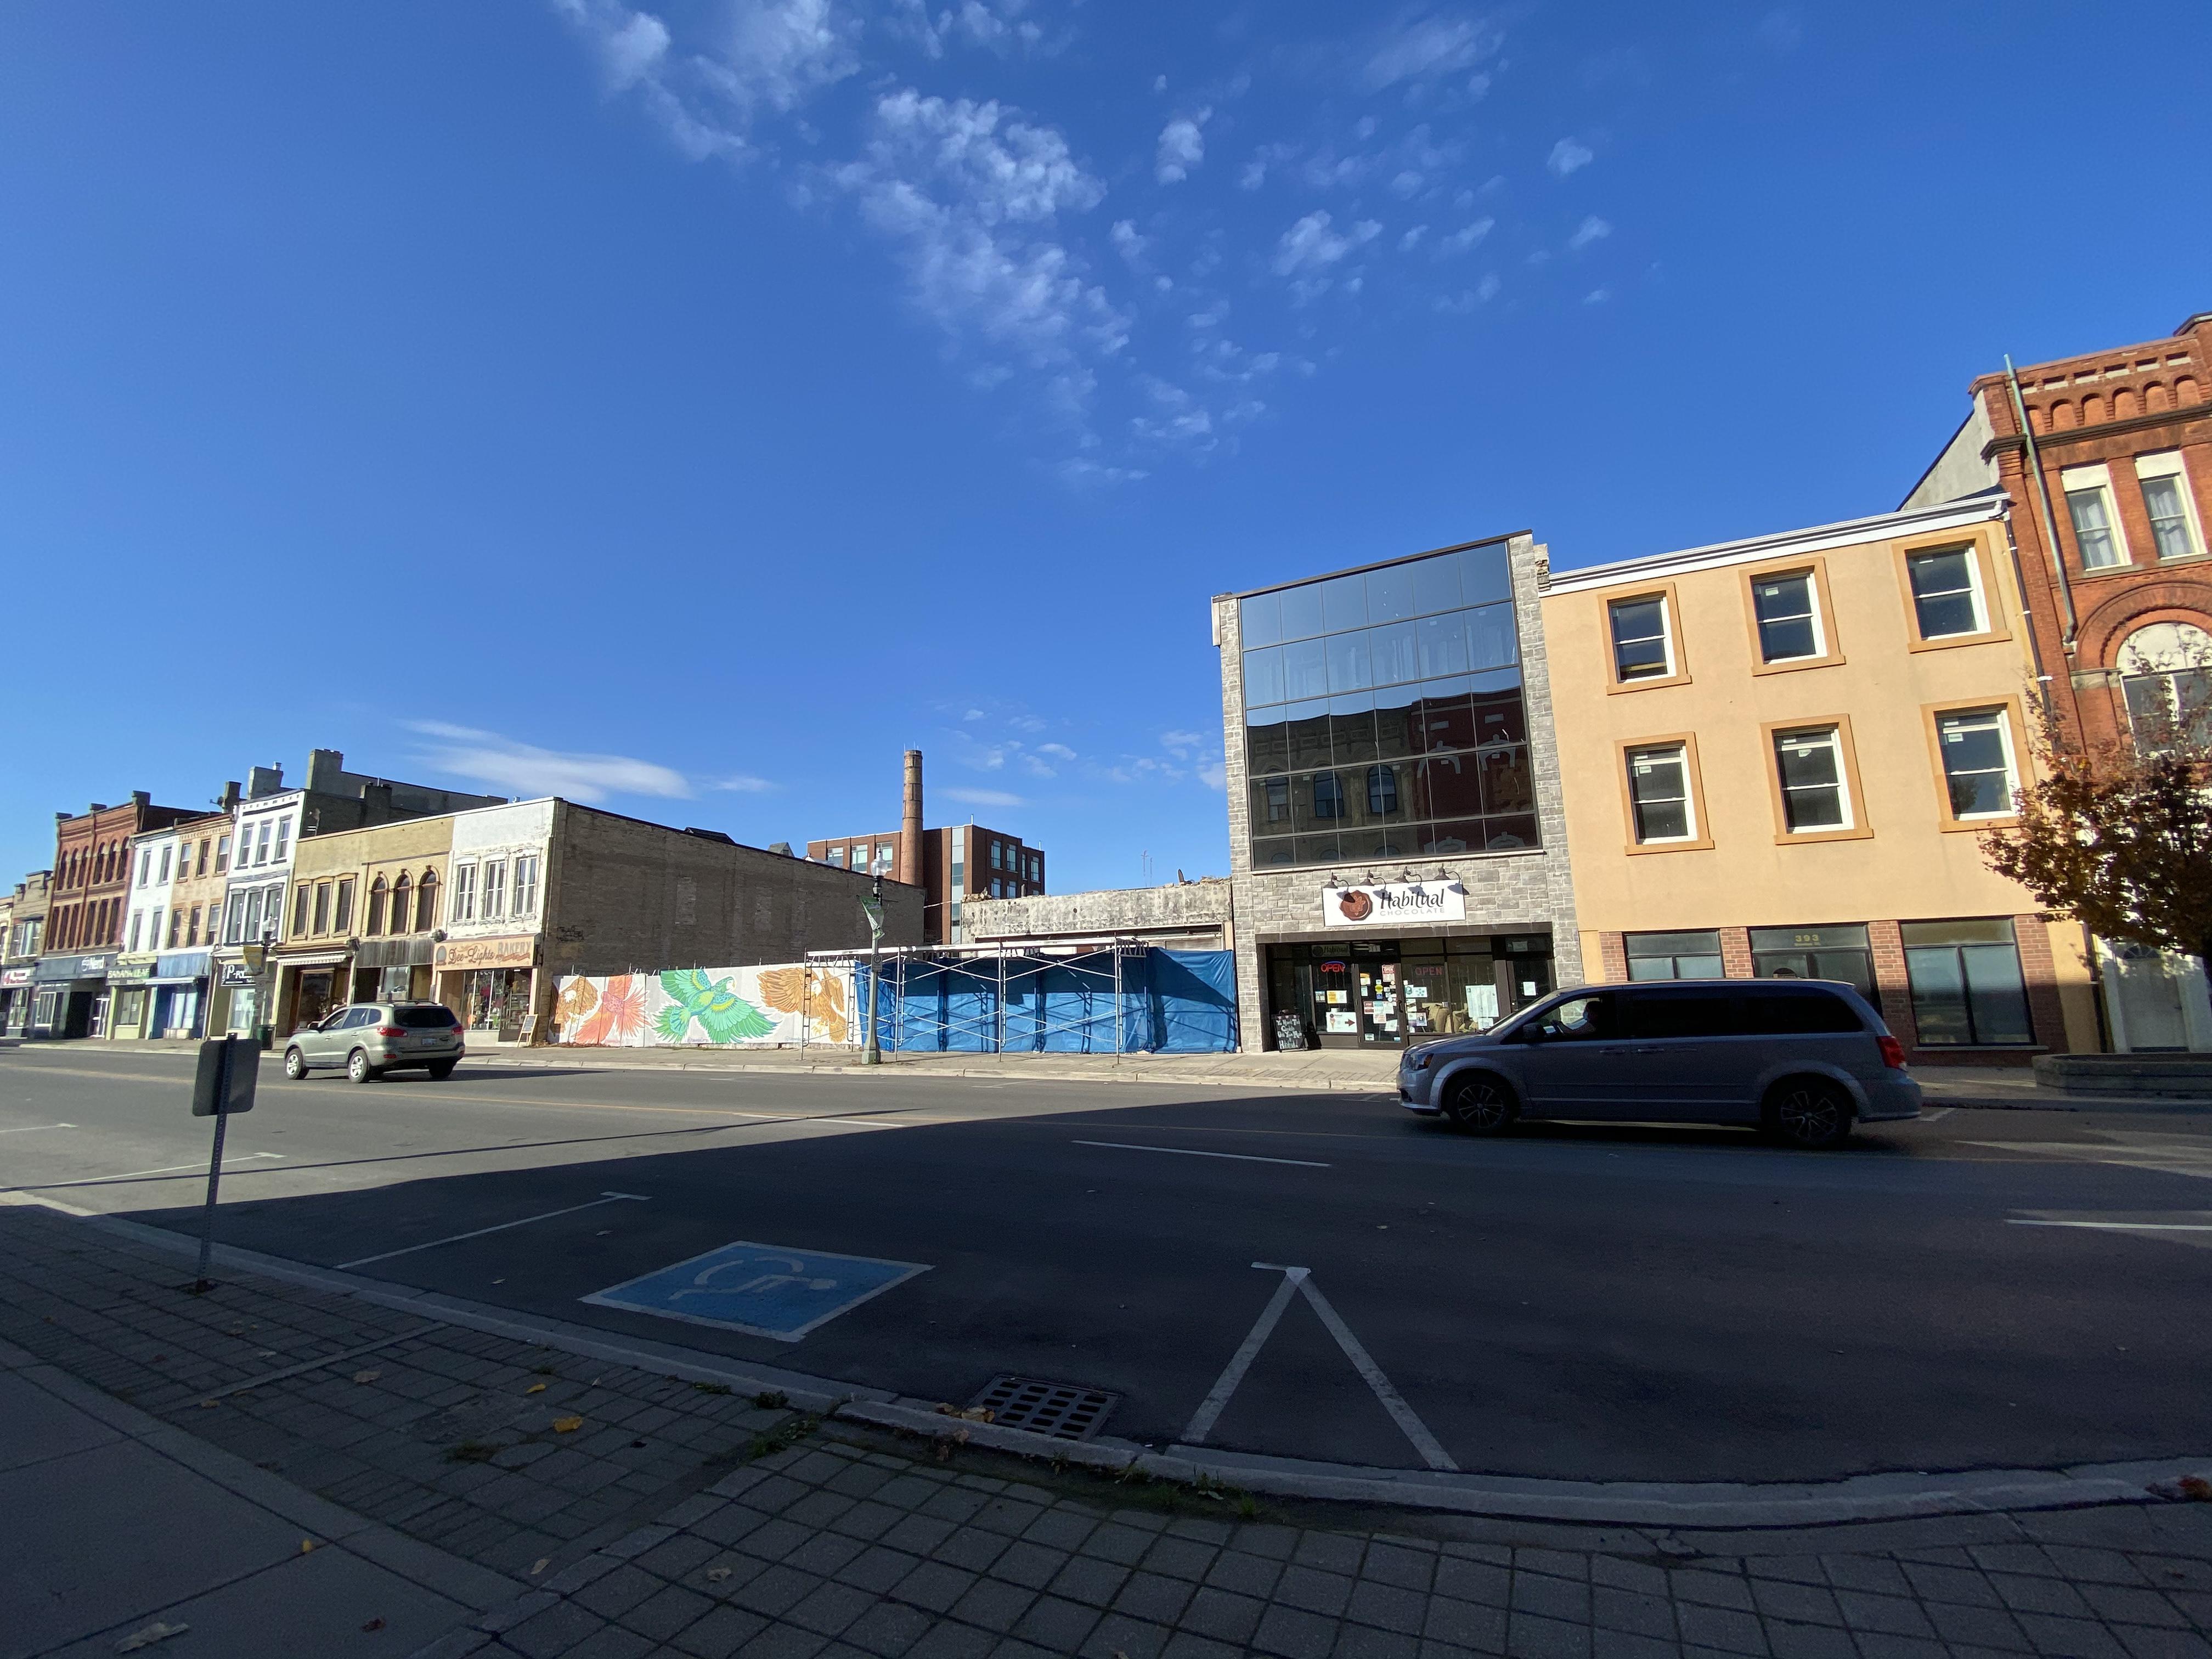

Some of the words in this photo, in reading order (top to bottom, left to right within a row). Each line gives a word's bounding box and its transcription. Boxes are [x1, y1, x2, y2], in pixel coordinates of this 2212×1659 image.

[1380, 888, 1444, 910] Habitual
[1380, 907, 1444, 917] CHOCOLATE
[1795, 934, 1819, 942] 393
[498, 941, 531, 955] BAKERY
[1321, 963, 1344, 973] OPEN
[1415, 967, 1443, 976] OPEN
